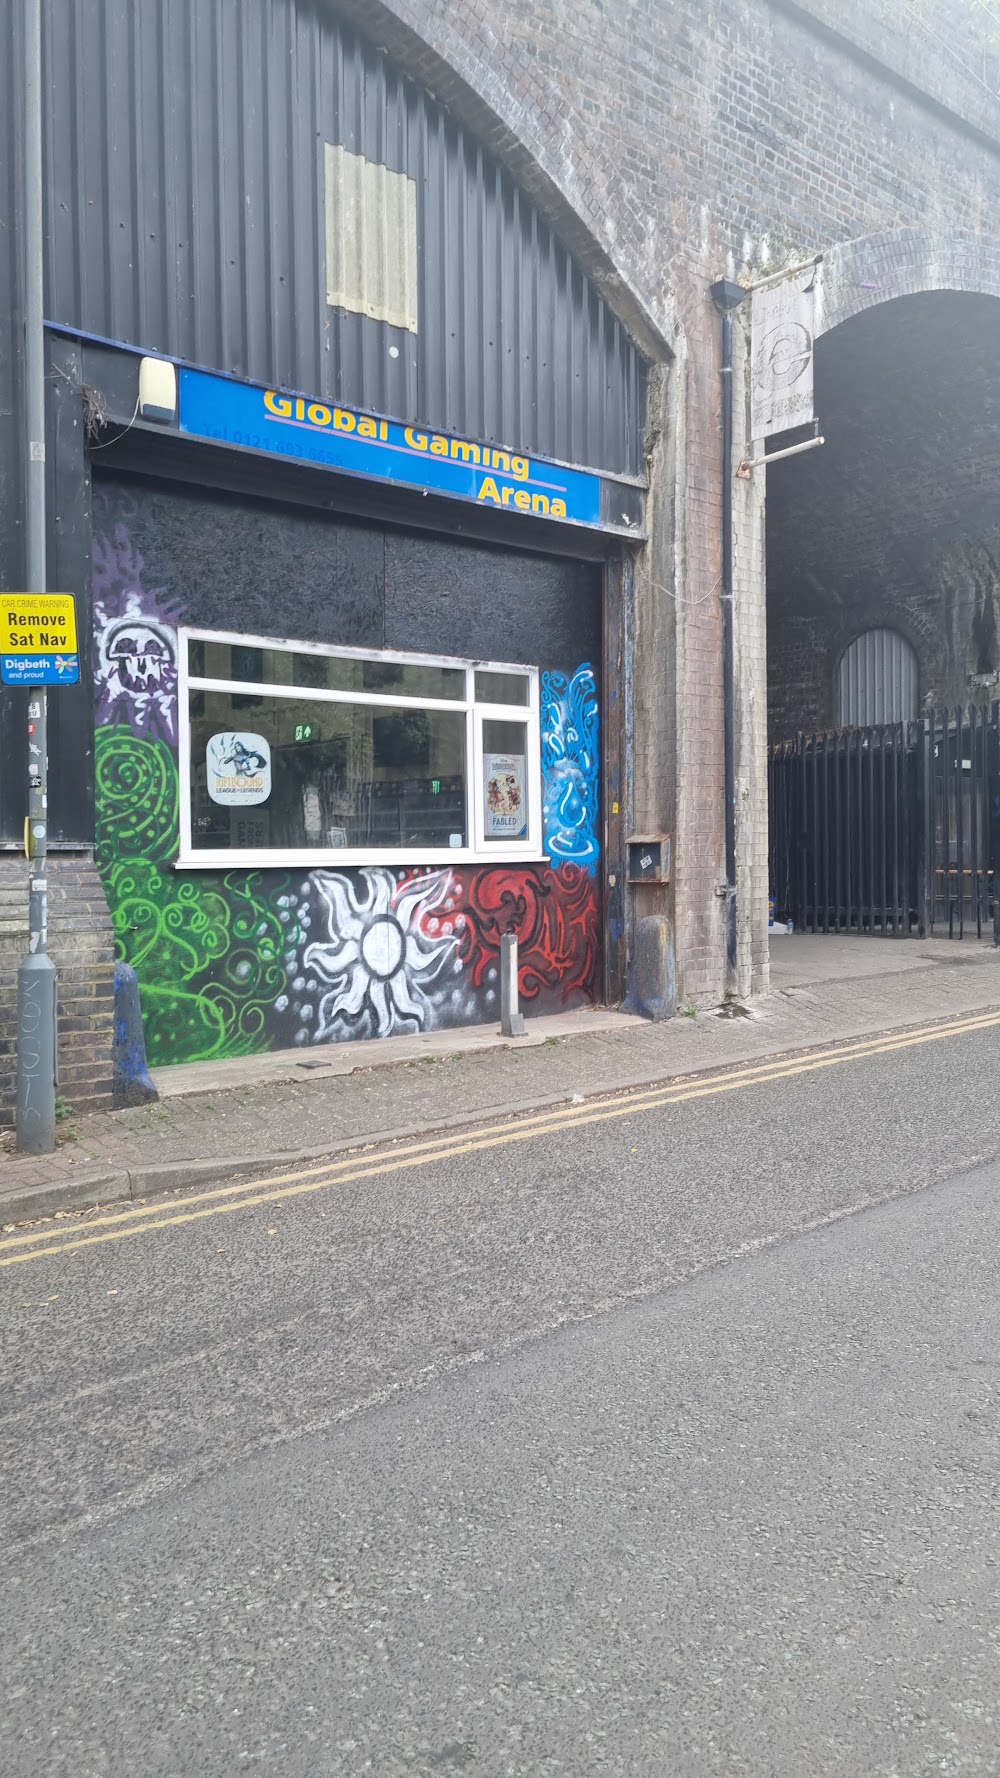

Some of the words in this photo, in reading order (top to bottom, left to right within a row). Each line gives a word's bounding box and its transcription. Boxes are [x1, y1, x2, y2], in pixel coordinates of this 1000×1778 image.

[263, 389, 388, 442] Global
[404, 426, 530, 482] Gaming
[477, 476, 567, 518] Arena
[1, 599, 15, 608] CAR
[17, 599, 37, 608] CRIME
[39, 599, 69, 608] WARNING
[8, 612, 66, 627] Remove
[10, 632, 34, 646] Sat
[40, 632, 67, 646] Nav
[5, 659, 50, 671] Digbeth
[215, 777, 264, 788] RIFTBOUND
[492, 817, 517, 826] FABLED
